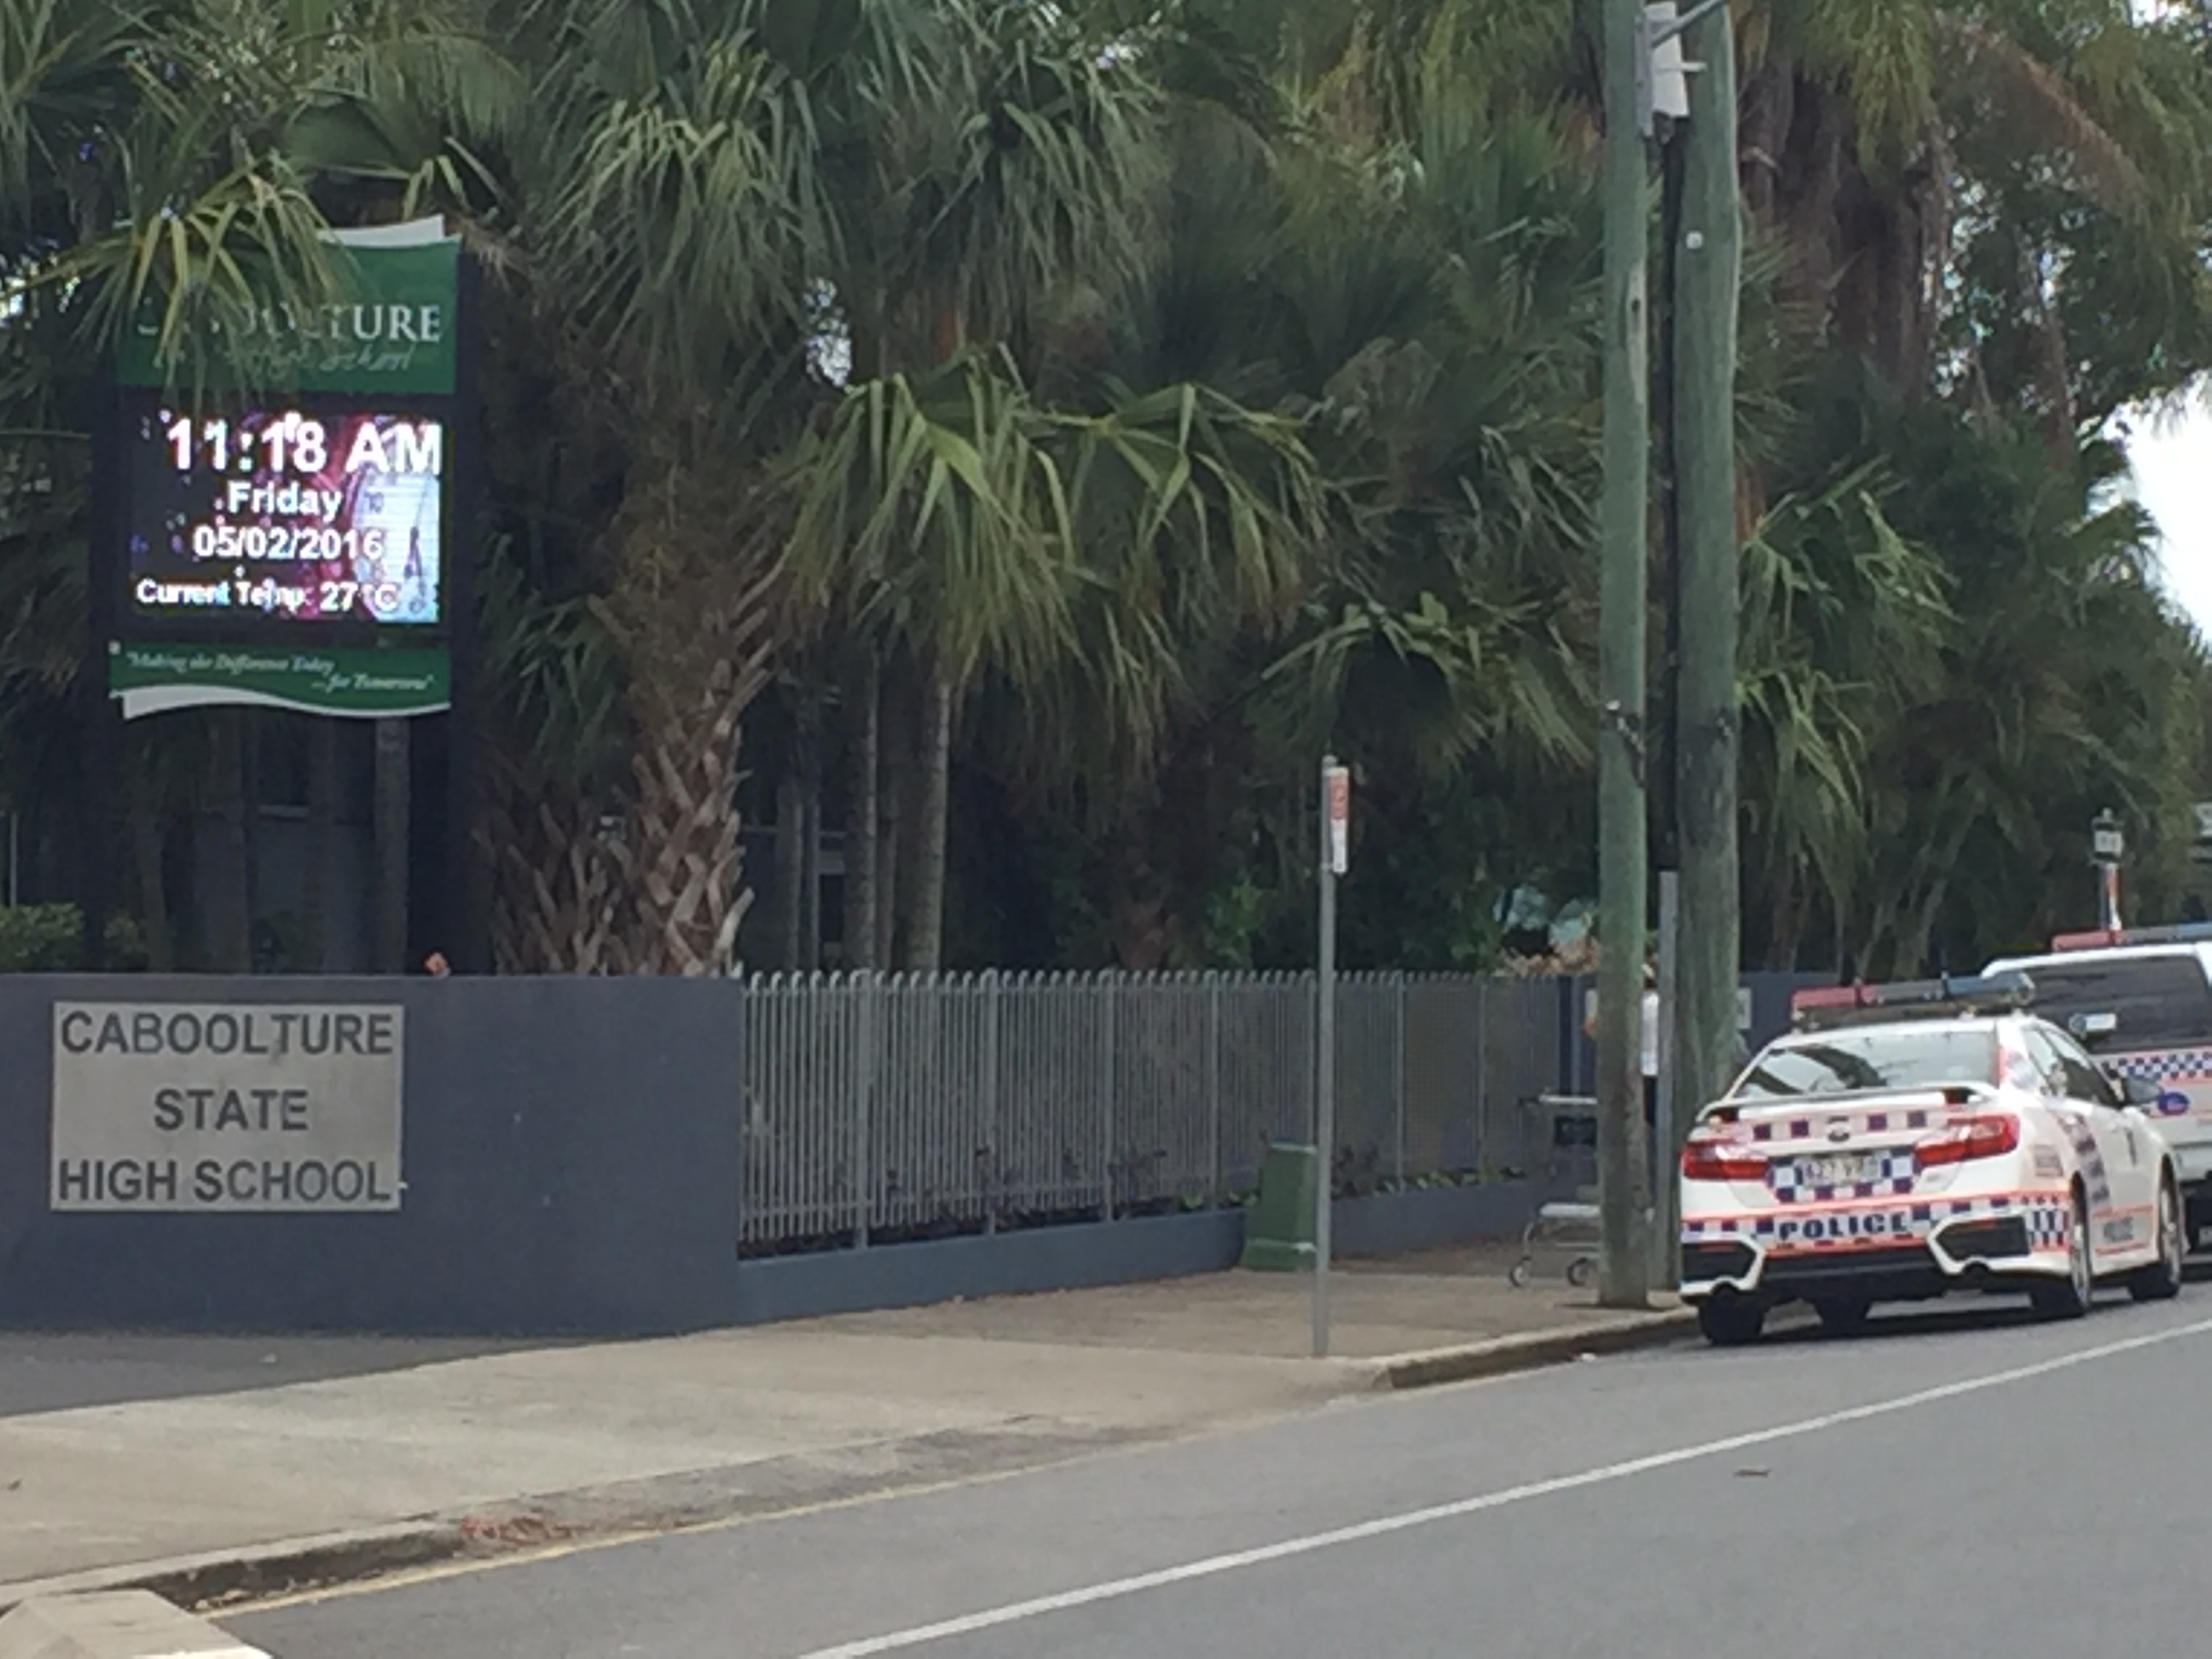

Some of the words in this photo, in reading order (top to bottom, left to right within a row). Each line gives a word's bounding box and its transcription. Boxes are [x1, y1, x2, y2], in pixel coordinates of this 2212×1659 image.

[344, 420, 442, 476] AM
[227, 480, 343, 523] Friday
[193, 524, 384, 561] 05/02/2016
[137, 578, 230, 606] Current
[60, 1010, 392, 1054] CABOOLTURE
[154, 1088, 308, 1130] STATE
[58, 1159, 177, 1201] HIGH
[194, 1160, 391, 1202] SCHOOL
[1778, 1210, 1908, 1242] POLICE
